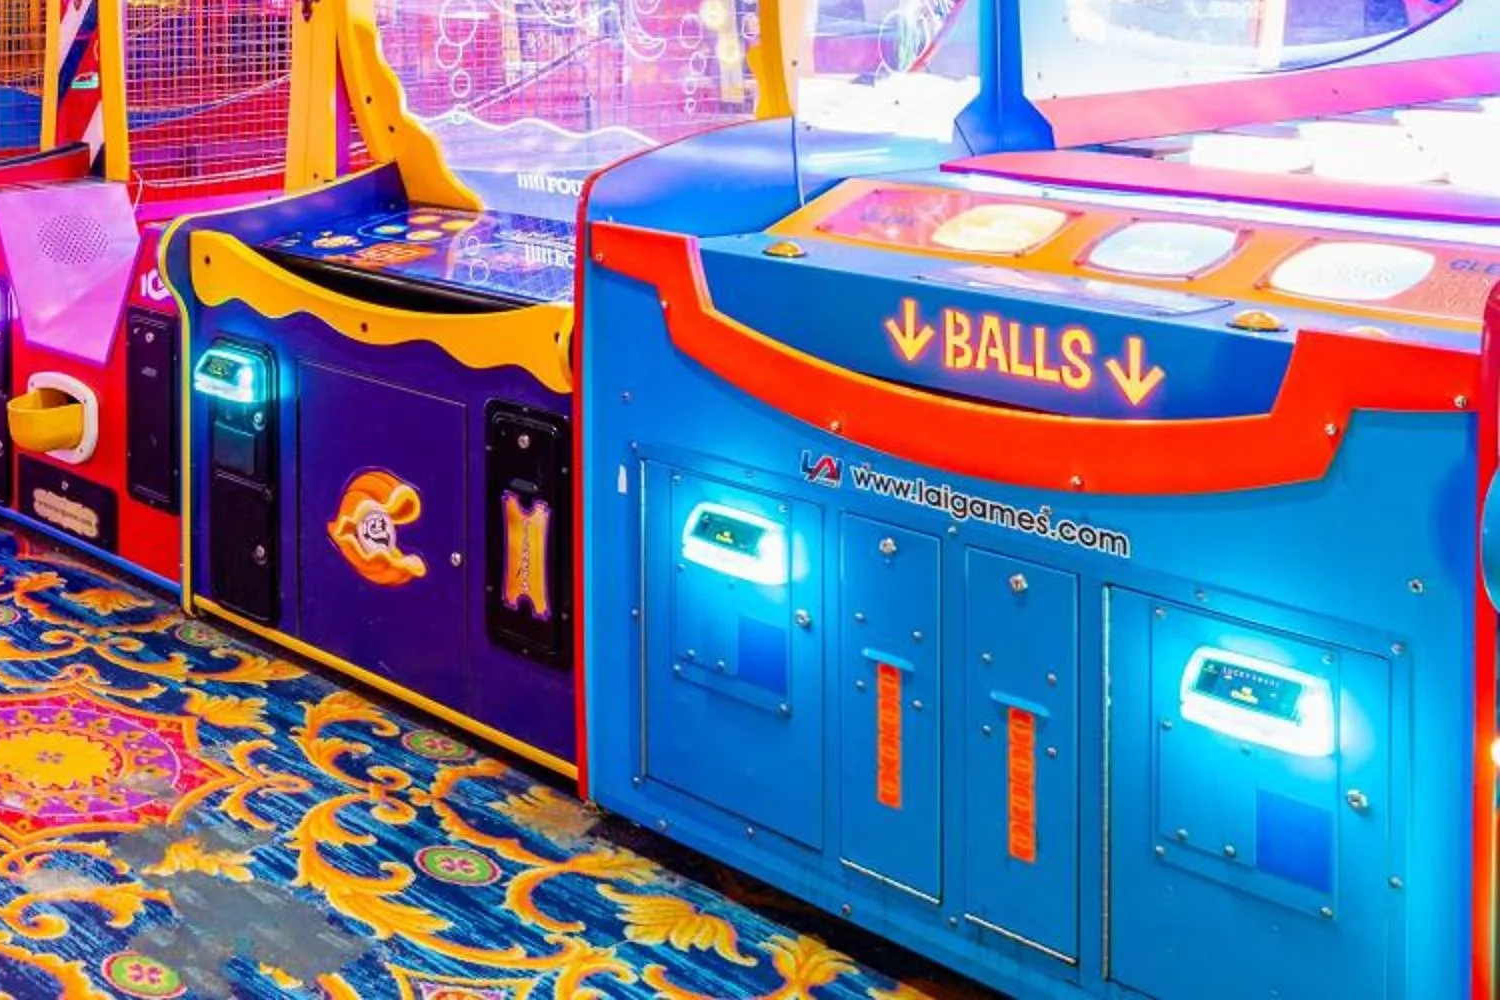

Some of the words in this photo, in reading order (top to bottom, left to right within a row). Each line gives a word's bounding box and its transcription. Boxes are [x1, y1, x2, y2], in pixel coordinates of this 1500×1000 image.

[944, 308, 1094, 391] BALLS
[801, 452, 843, 482] LAI
[851, 465, 1132, 558] www.laigames.com
